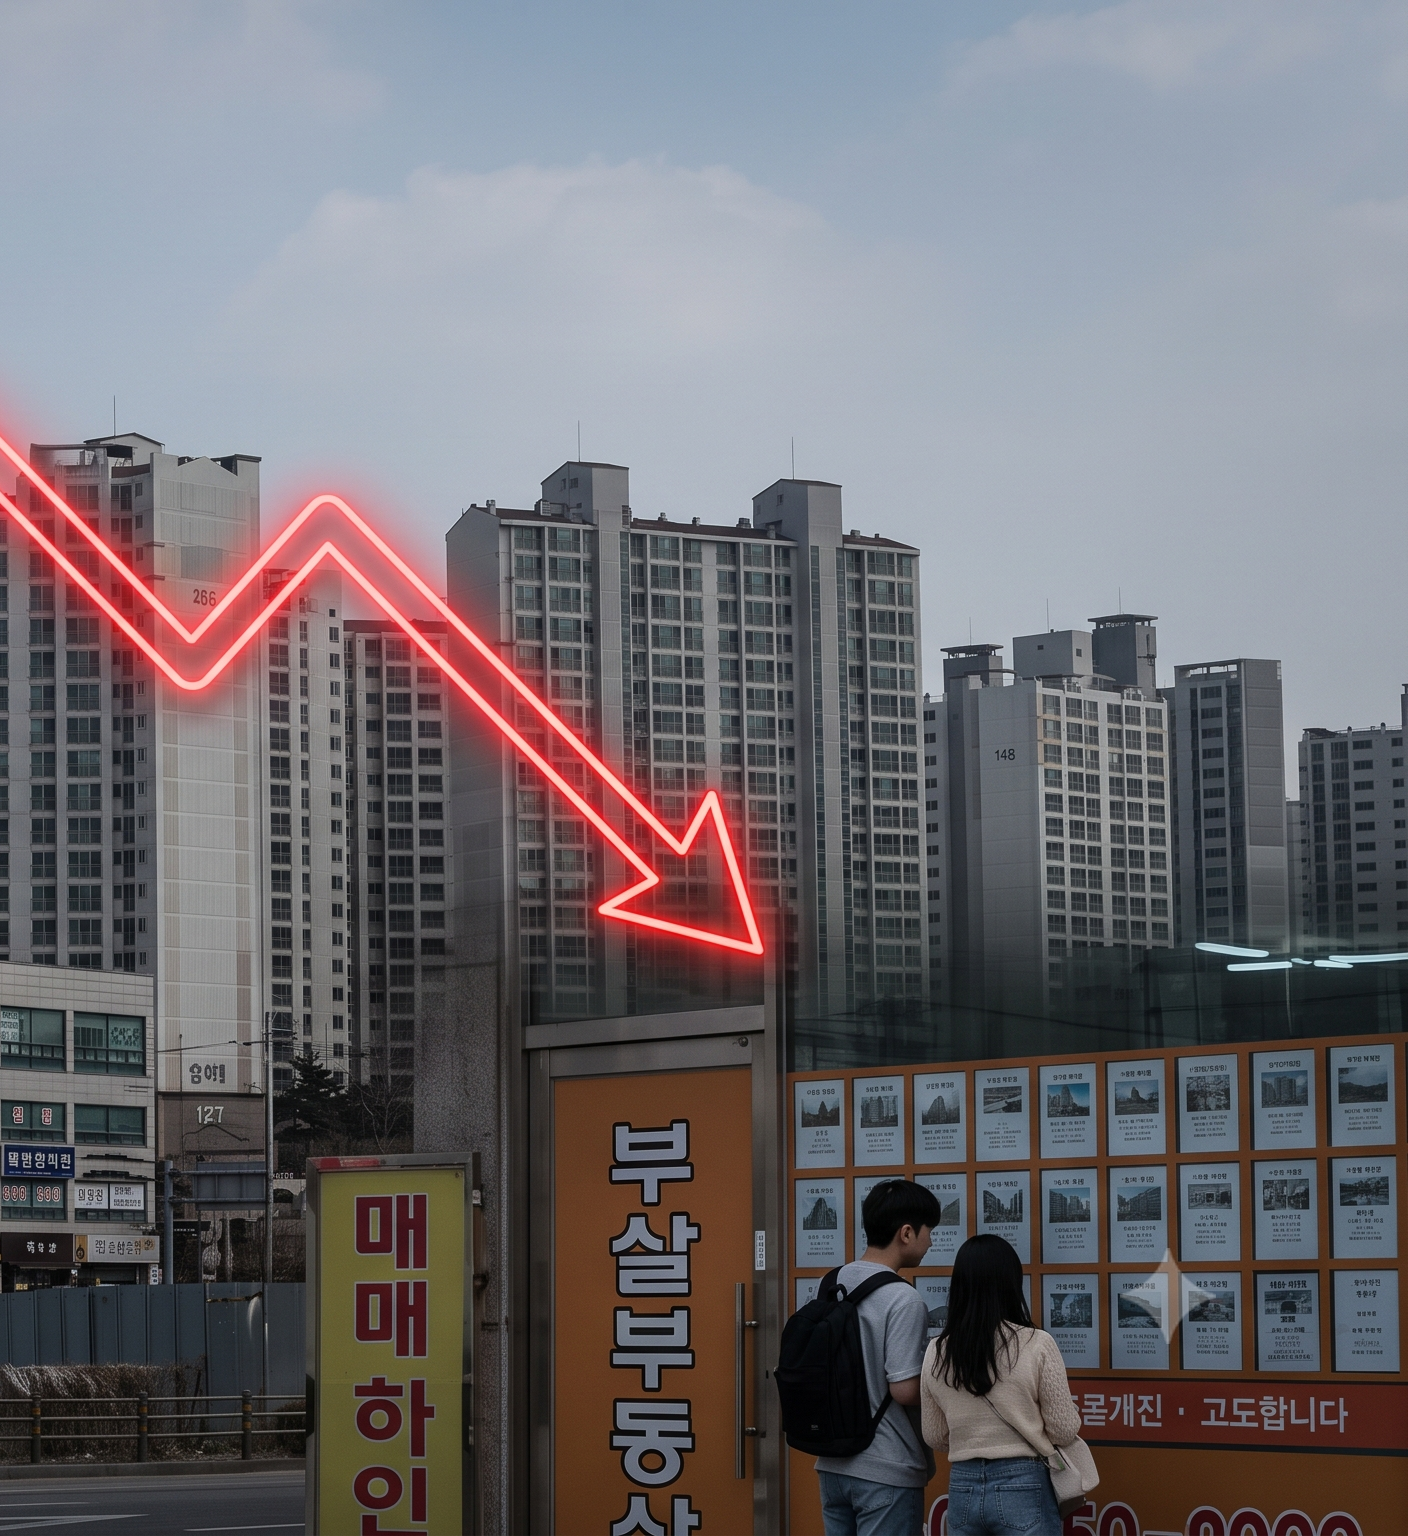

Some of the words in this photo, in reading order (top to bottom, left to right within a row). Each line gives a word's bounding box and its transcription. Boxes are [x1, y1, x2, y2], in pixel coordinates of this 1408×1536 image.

[192, 588, 217, 607] 266
[994, 748, 1016, 761] 148
[196, 1105, 224, 1124] 127
[1200, 1395, 1349, 1433] 고도합니다
